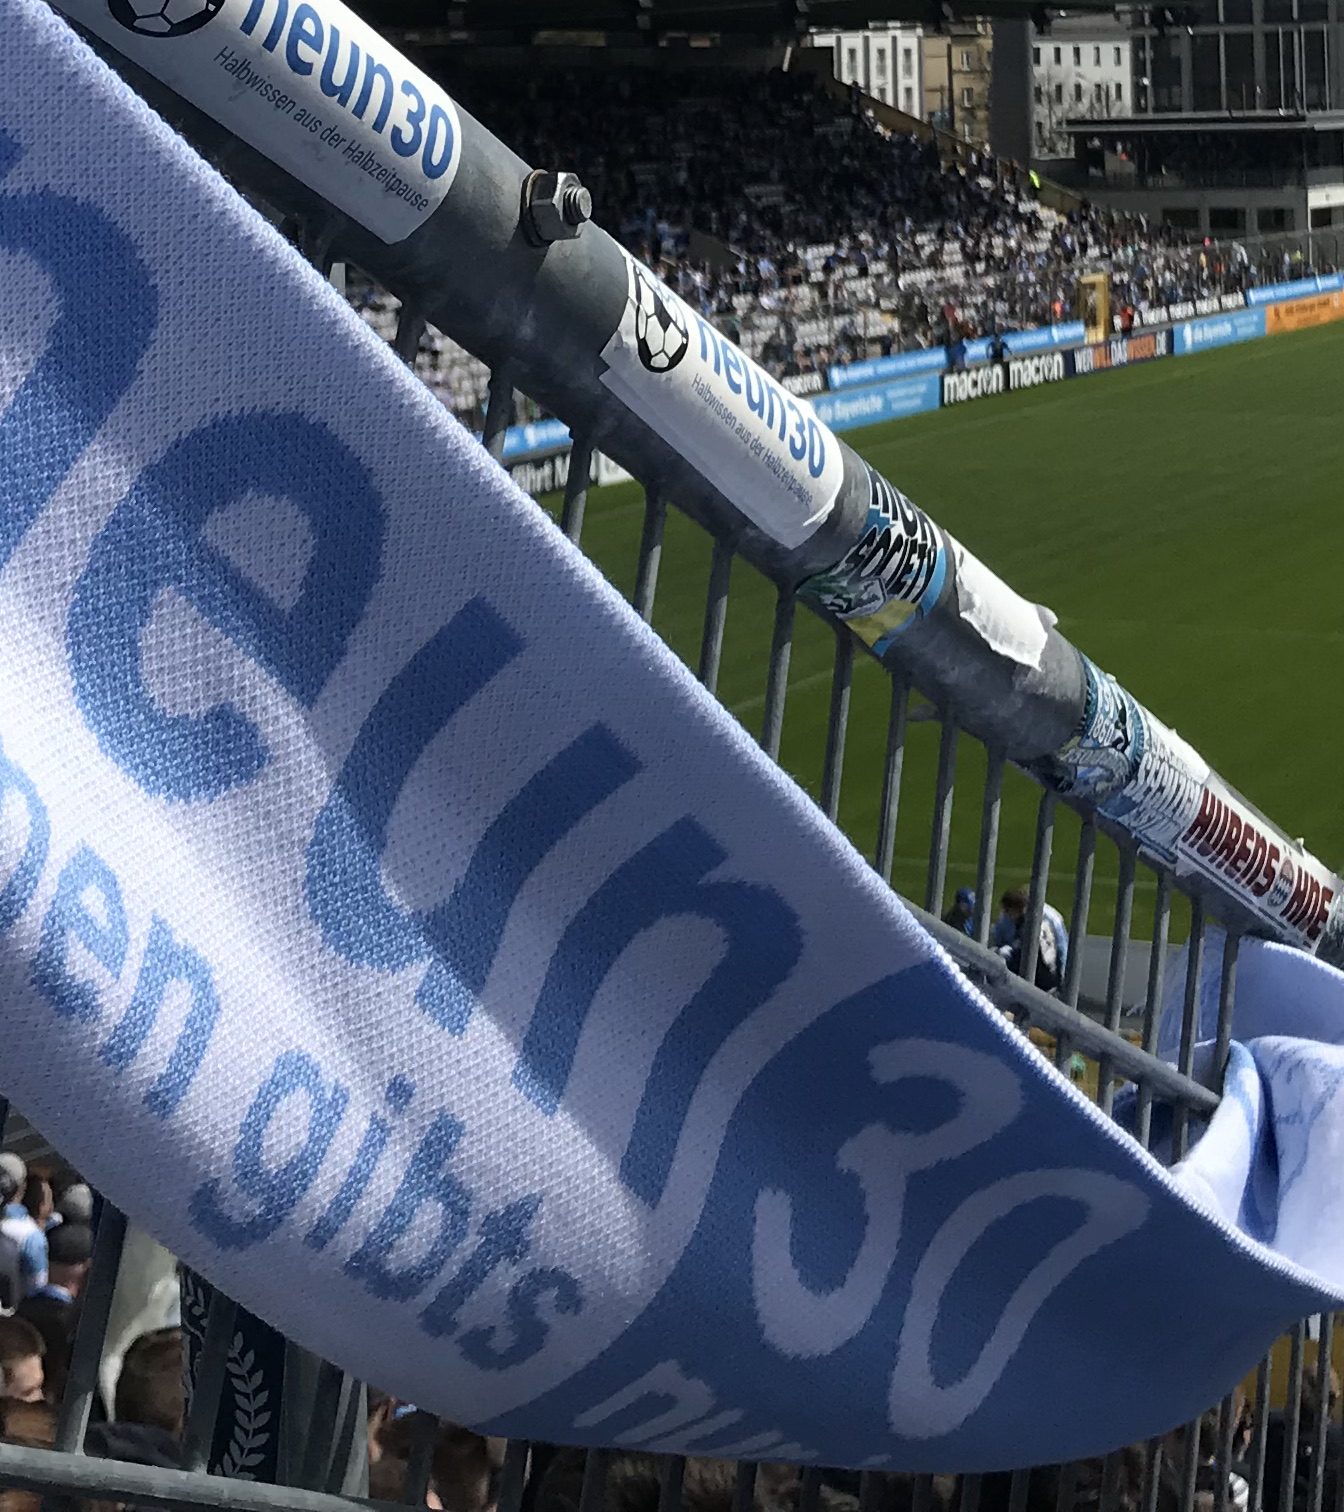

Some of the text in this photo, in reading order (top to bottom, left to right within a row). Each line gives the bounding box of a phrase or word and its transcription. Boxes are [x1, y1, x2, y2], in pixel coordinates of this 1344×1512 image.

[213, 46, 431, 214] Halbwissen aus der Halbzeitpause
[692, 311, 827, 479] neun30
[943, 364, 1004, 406] macron
[1009, 351, 1065, 390] macron
[690, 373, 738, 437] Halbwissen
[734, 426, 753, 451] aus
[749, 437, 767, 465] der
[851, 524, 937, 604] SOCIETY
[189, 1048, 587, 1372] gibts
